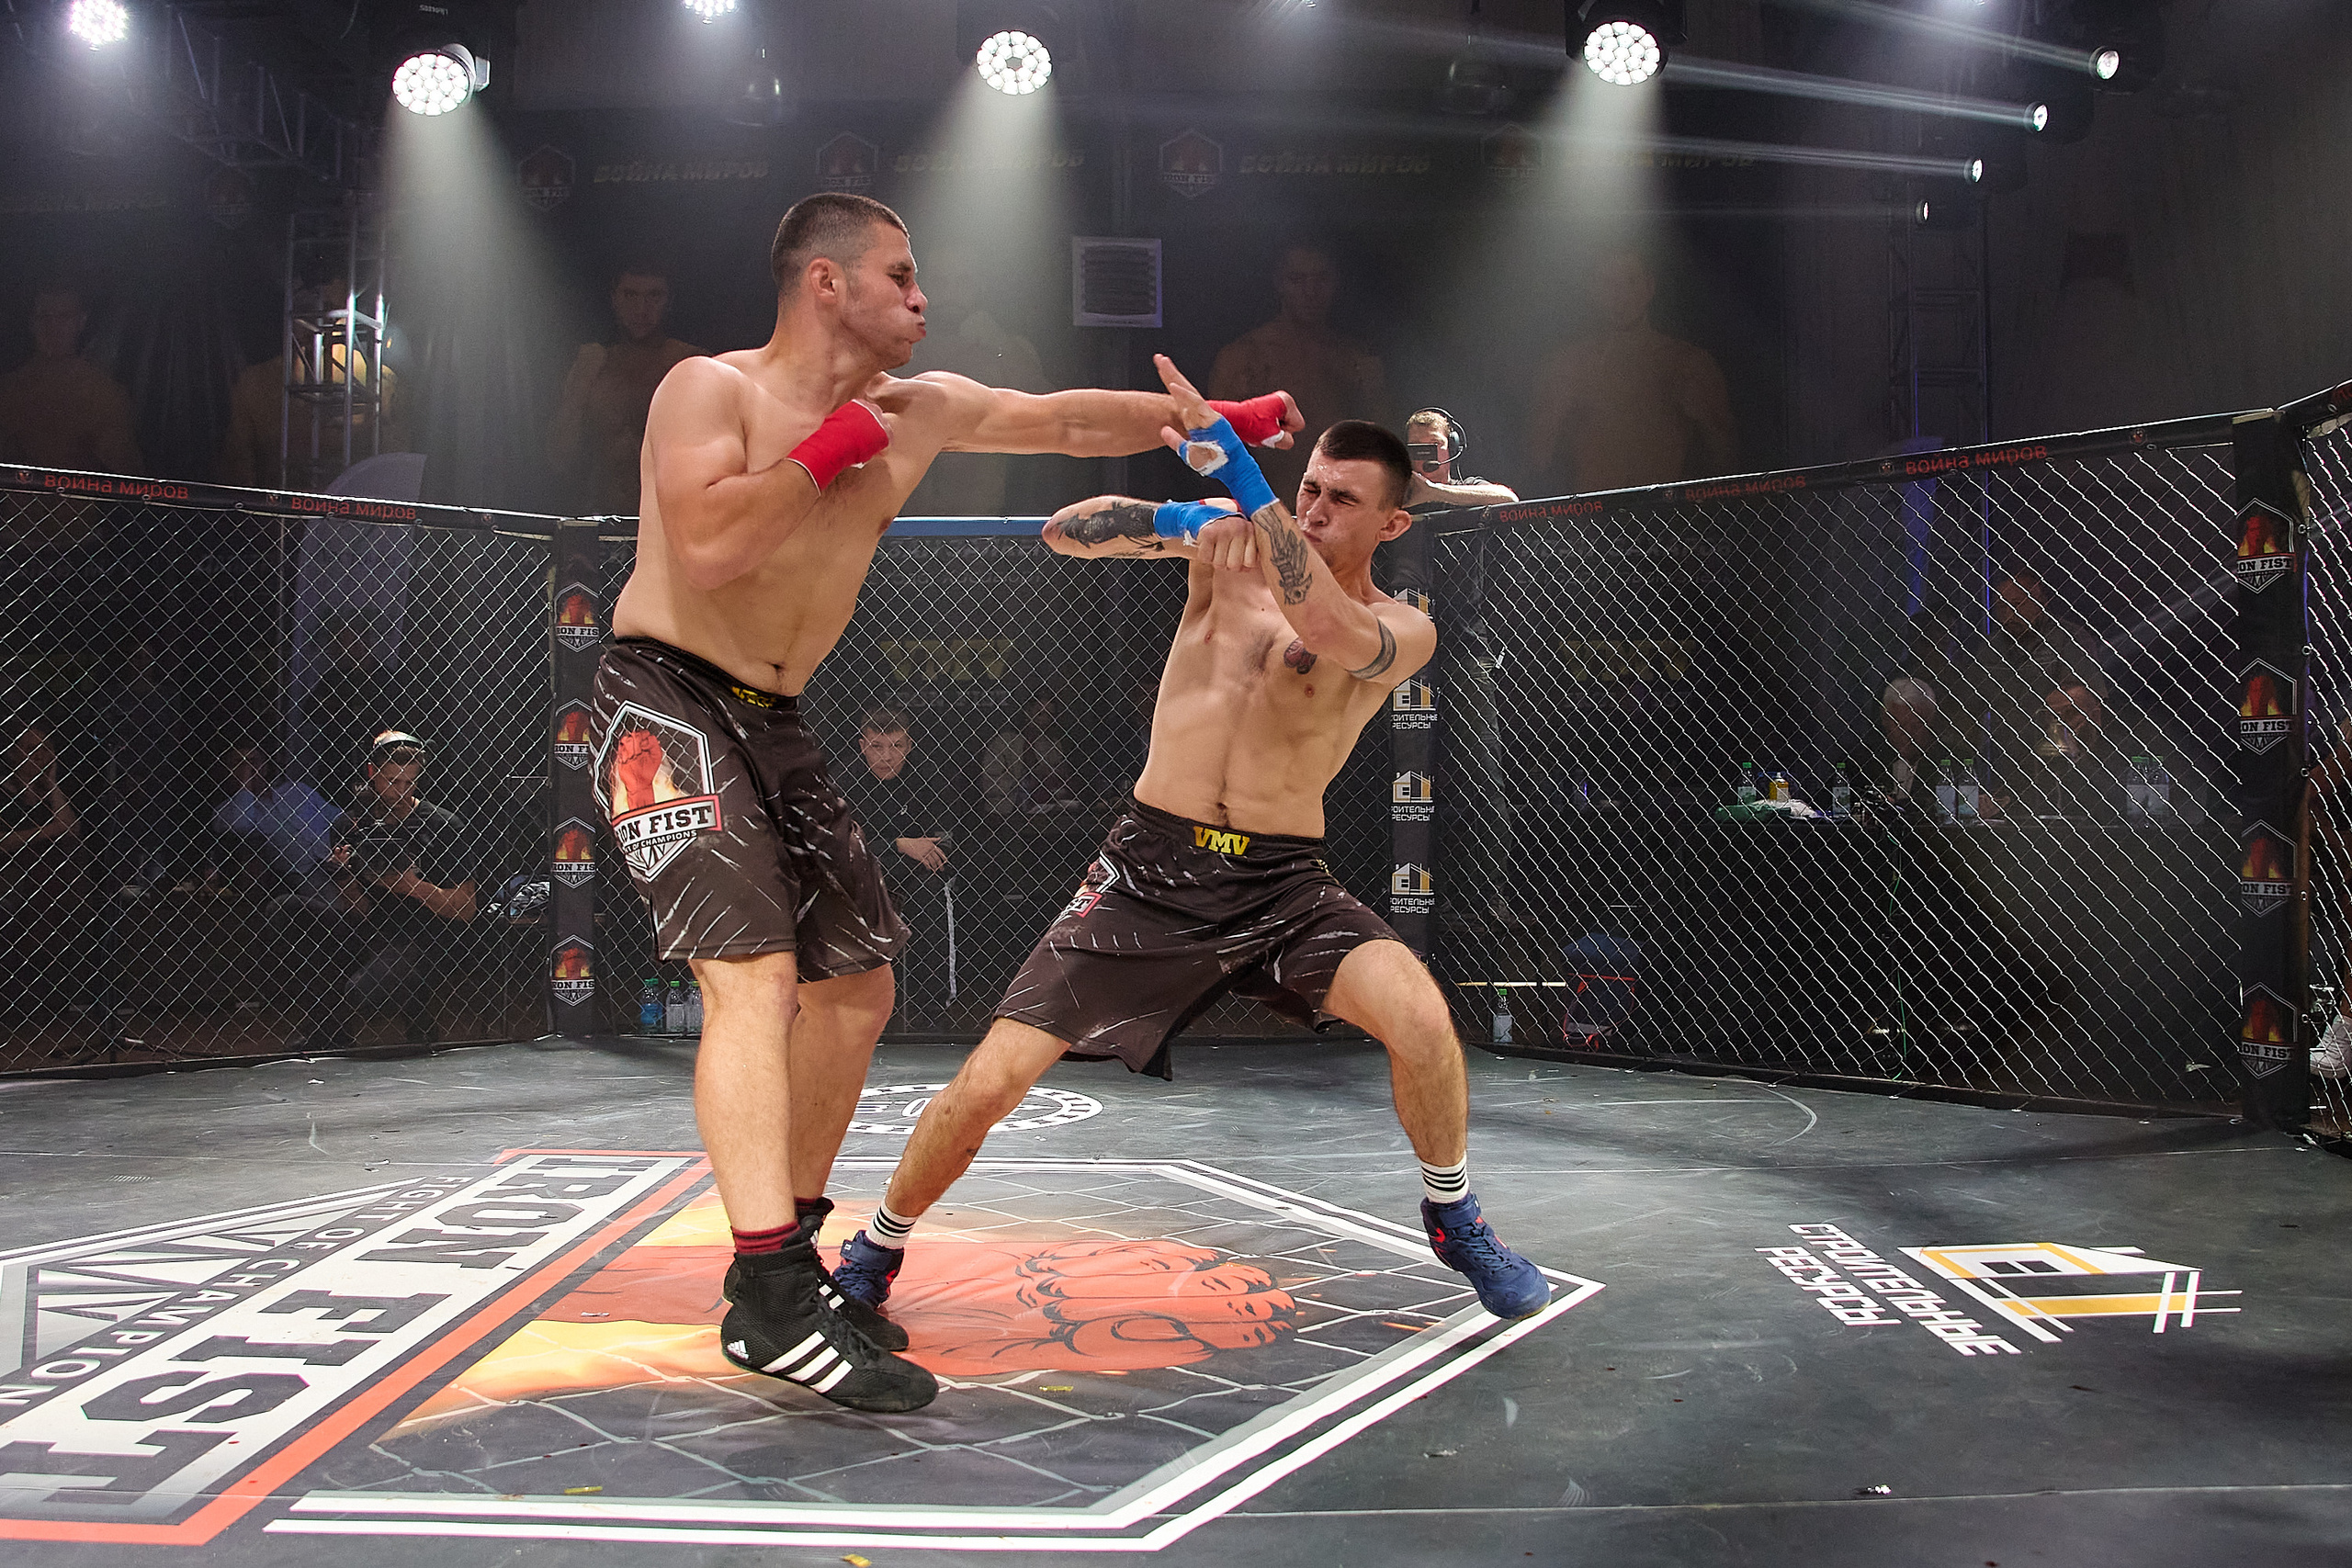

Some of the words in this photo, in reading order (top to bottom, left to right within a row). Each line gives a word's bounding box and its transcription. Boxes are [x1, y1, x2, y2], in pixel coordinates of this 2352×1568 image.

[639, 829, 698, 847] CHAMPIONS
[649, 806, 712, 834] FIST
[1193, 827, 1250, 855] VMV
[354, 1156, 662, 1270] IRON
[355, 1176, 474, 1222] FIGHT
[288, 1226, 366, 1250] OF
[1754, 1246, 1903, 1326] РЕСУРСЫ
[1787, 1222, 2022, 1357] СТРОИТЕЛЬНЫЕ
[0, 1288, 454, 1506] FIST
